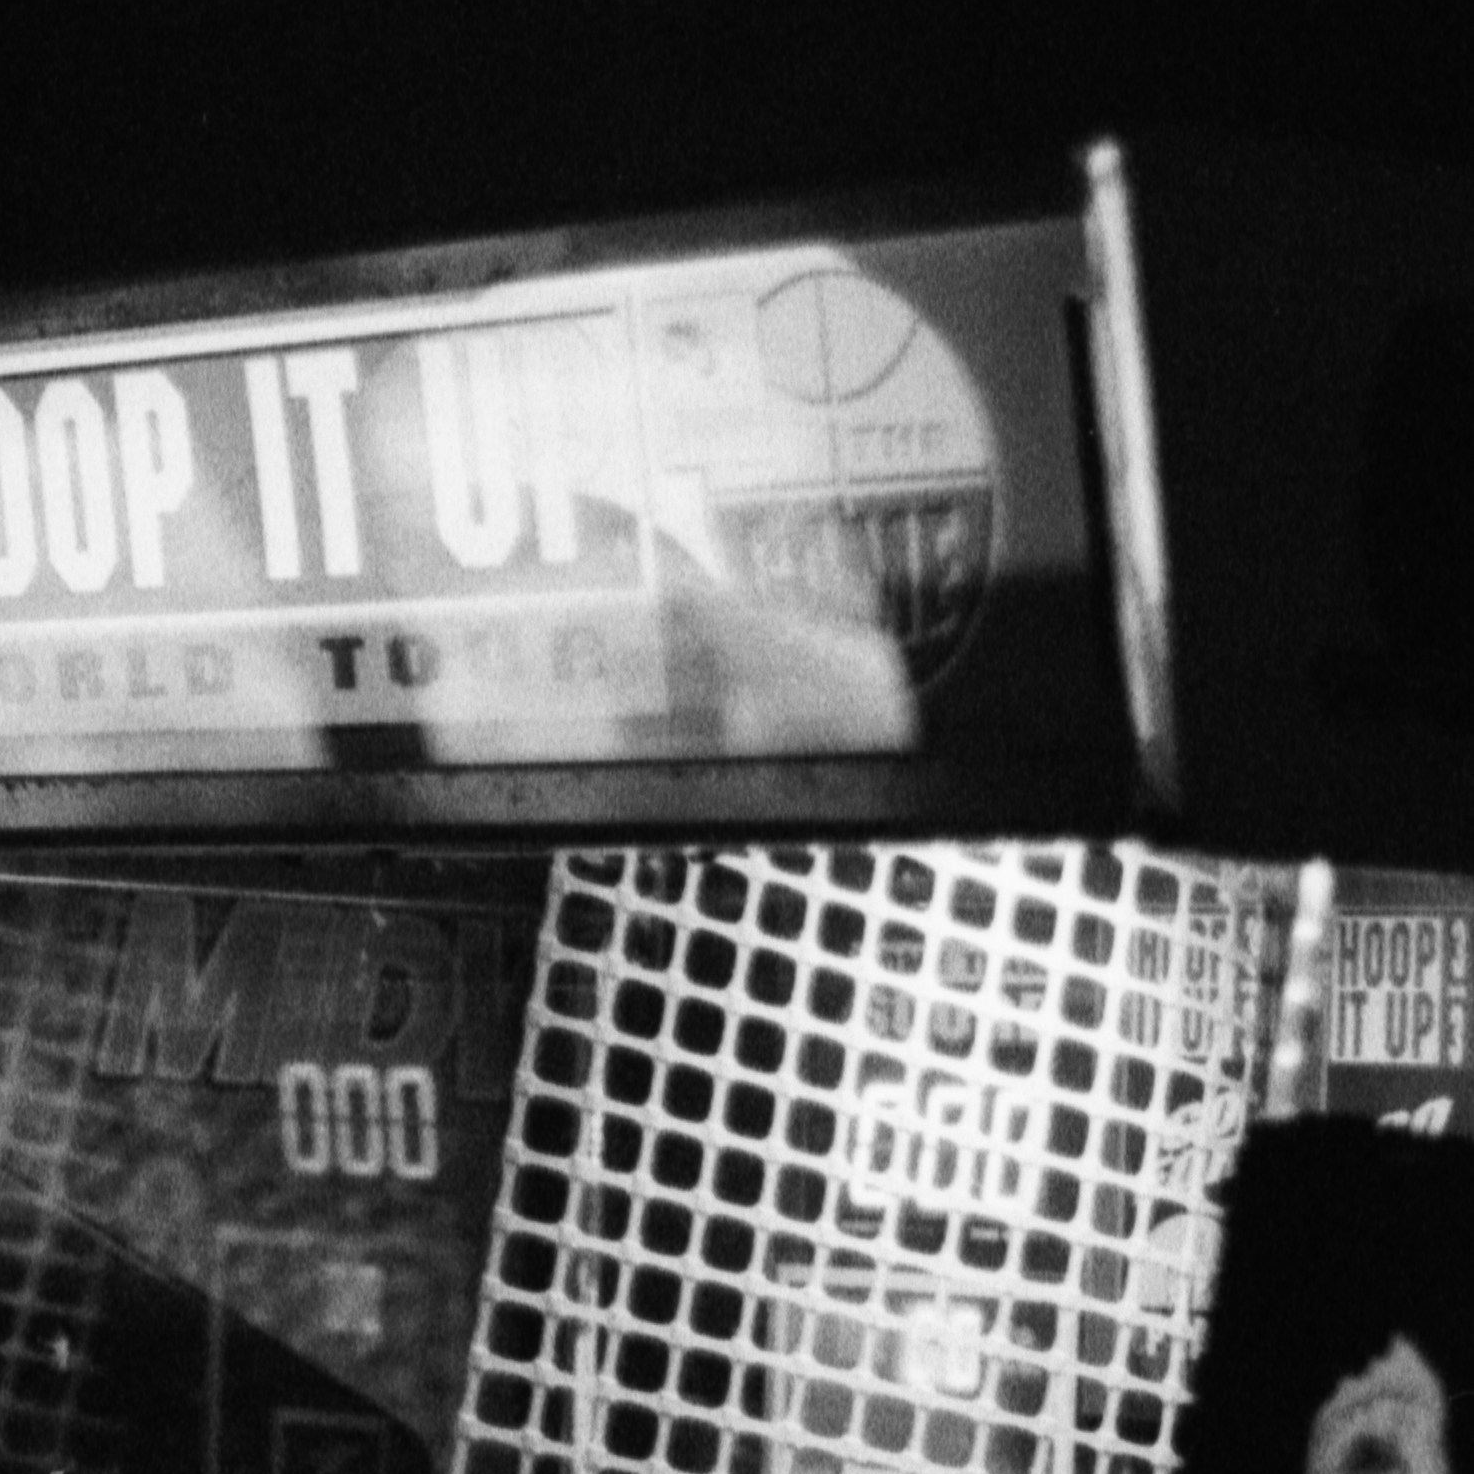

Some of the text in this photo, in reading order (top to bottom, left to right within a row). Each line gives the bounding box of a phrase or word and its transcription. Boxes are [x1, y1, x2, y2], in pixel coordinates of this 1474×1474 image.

[243, 348, 360, 581] IT
[1337, 920, 1436, 988] HOOP
[1336, 990, 1435, 1058] IT UP
